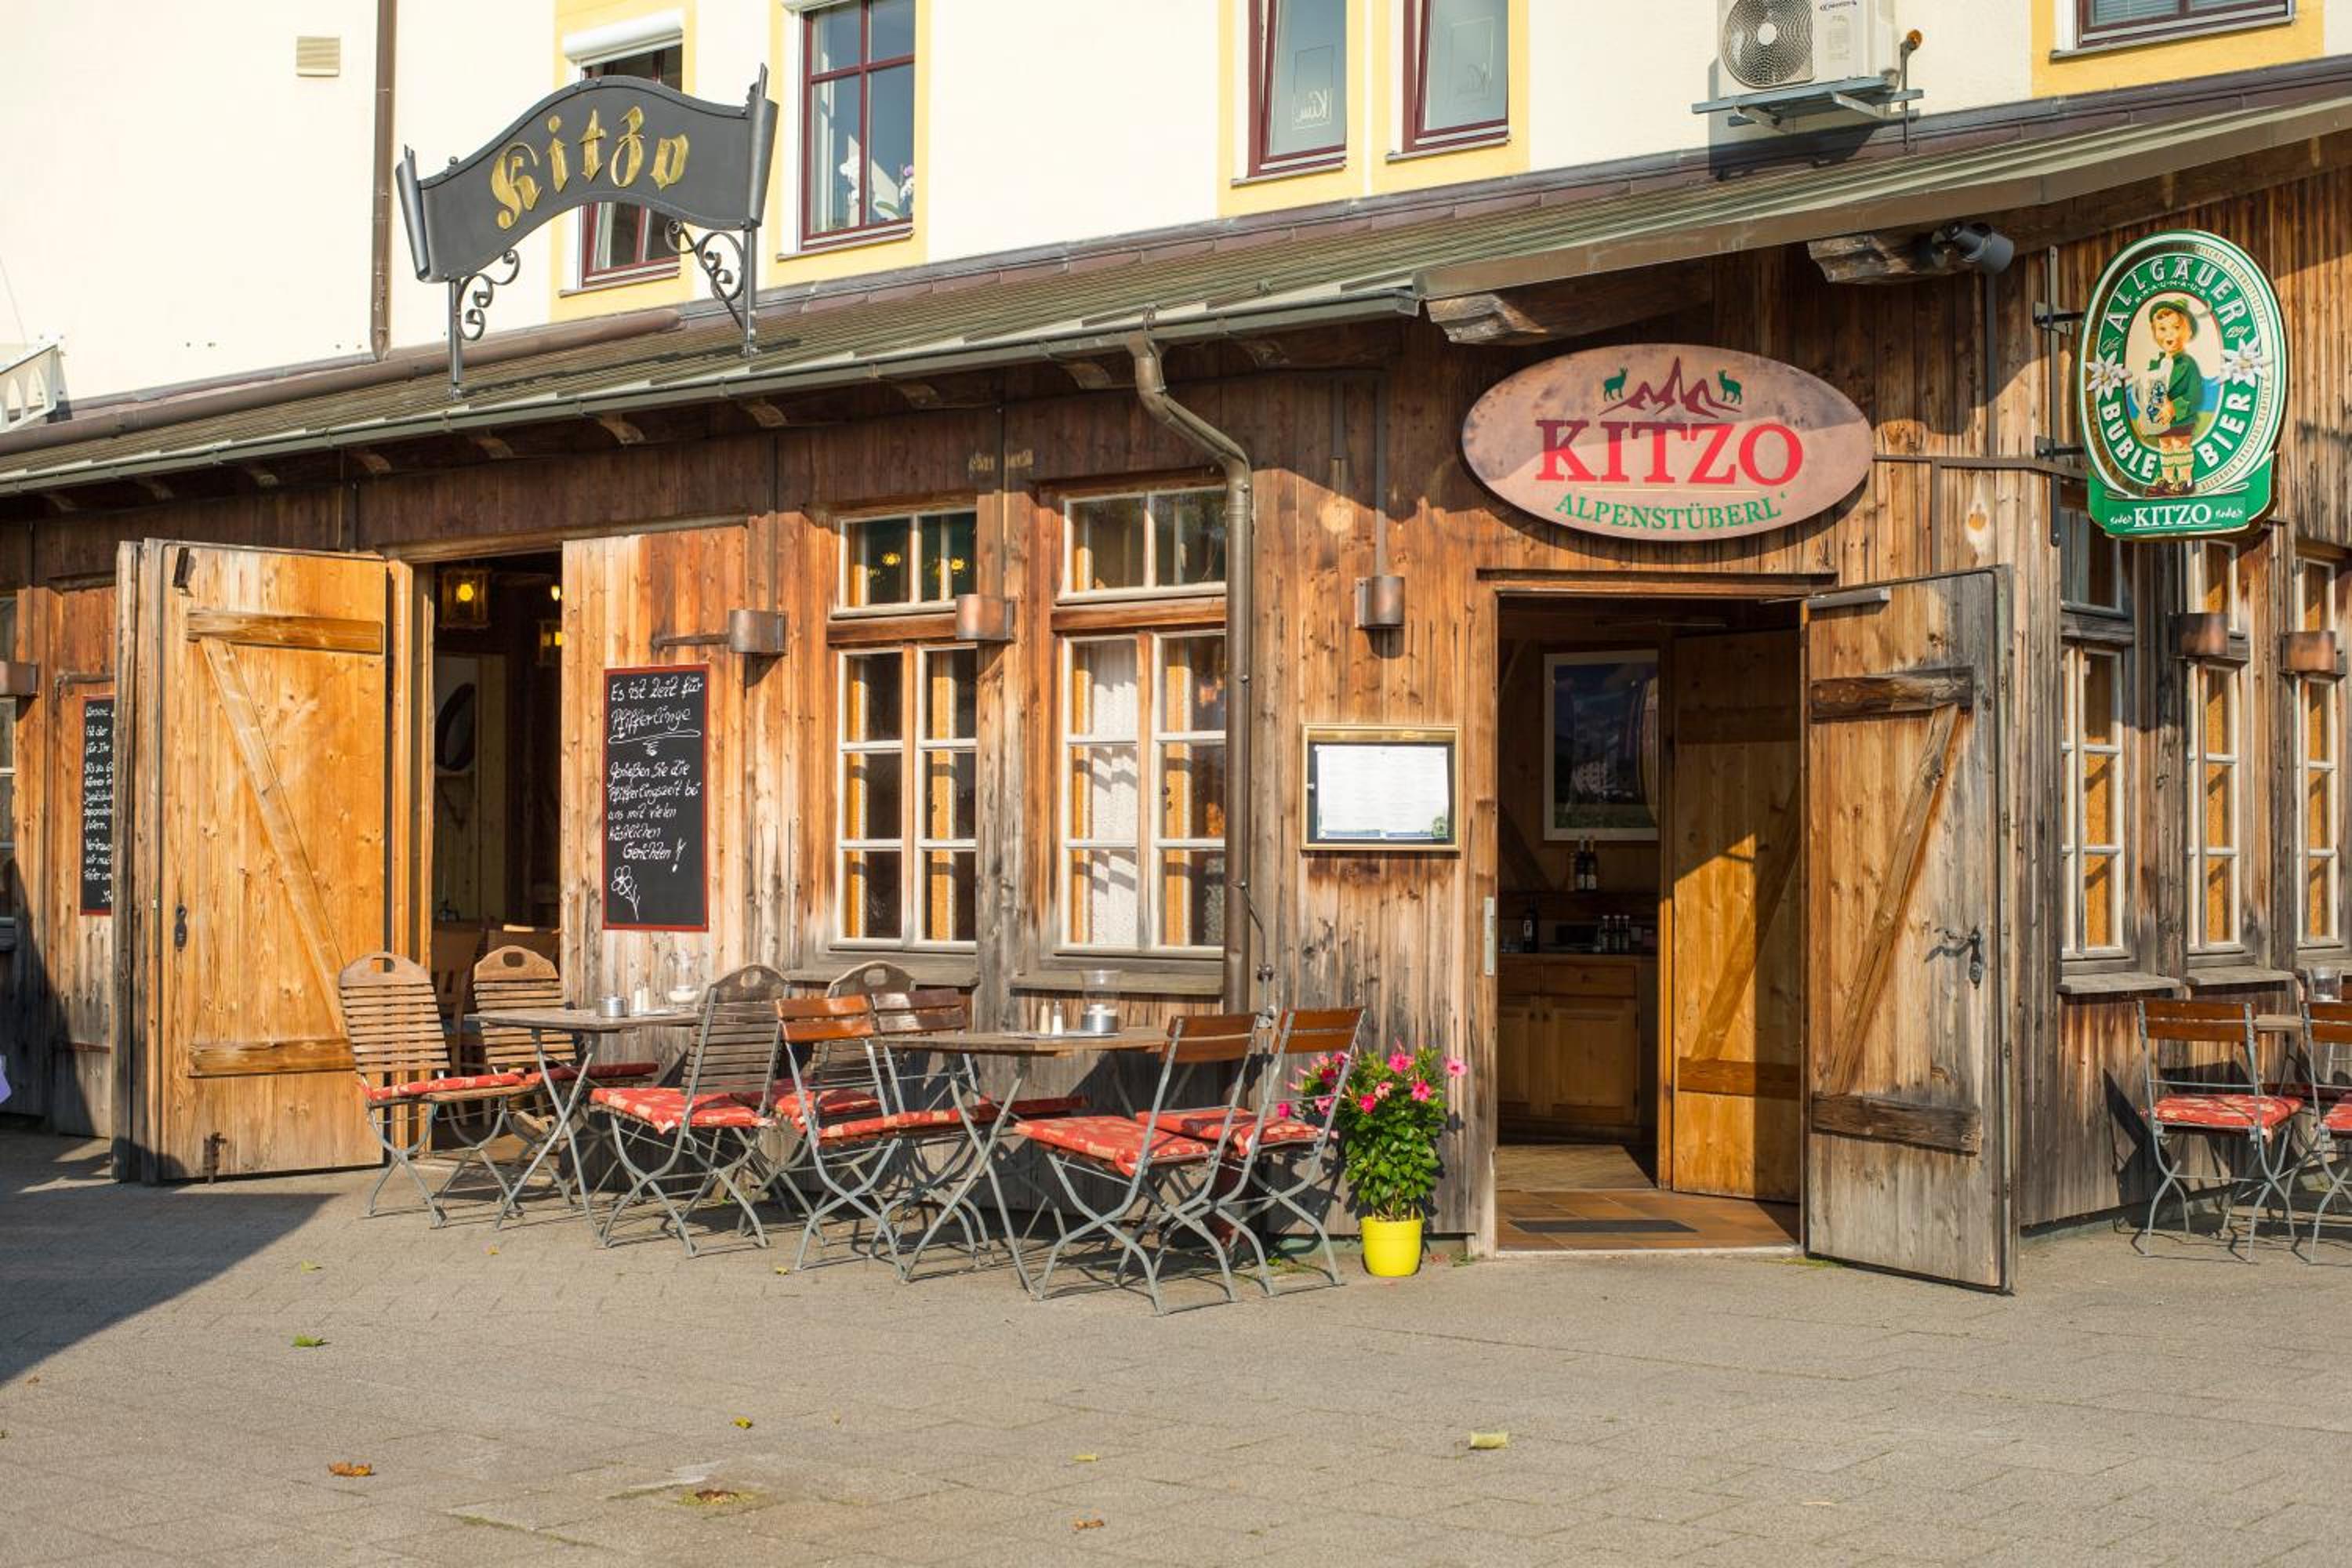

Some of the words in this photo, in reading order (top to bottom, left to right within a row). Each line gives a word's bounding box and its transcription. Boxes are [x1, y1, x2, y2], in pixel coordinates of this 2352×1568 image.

[491, 106, 690, 230] Kitzo
[2196, 393, 2251, 468] BIER
[1535, 419, 1803, 486] KITZO
[2133, 503, 2212, 528] KITZO
[611, 682, 625, 702] Es
[628, 678, 647, 700] ist
[649, 676, 679, 699] Zeit
[681, 676, 703, 699] für
[611, 706, 691, 736] Pfifferlinge
[651, 761, 669, 779] Sie
[670, 760, 691, 776] die
